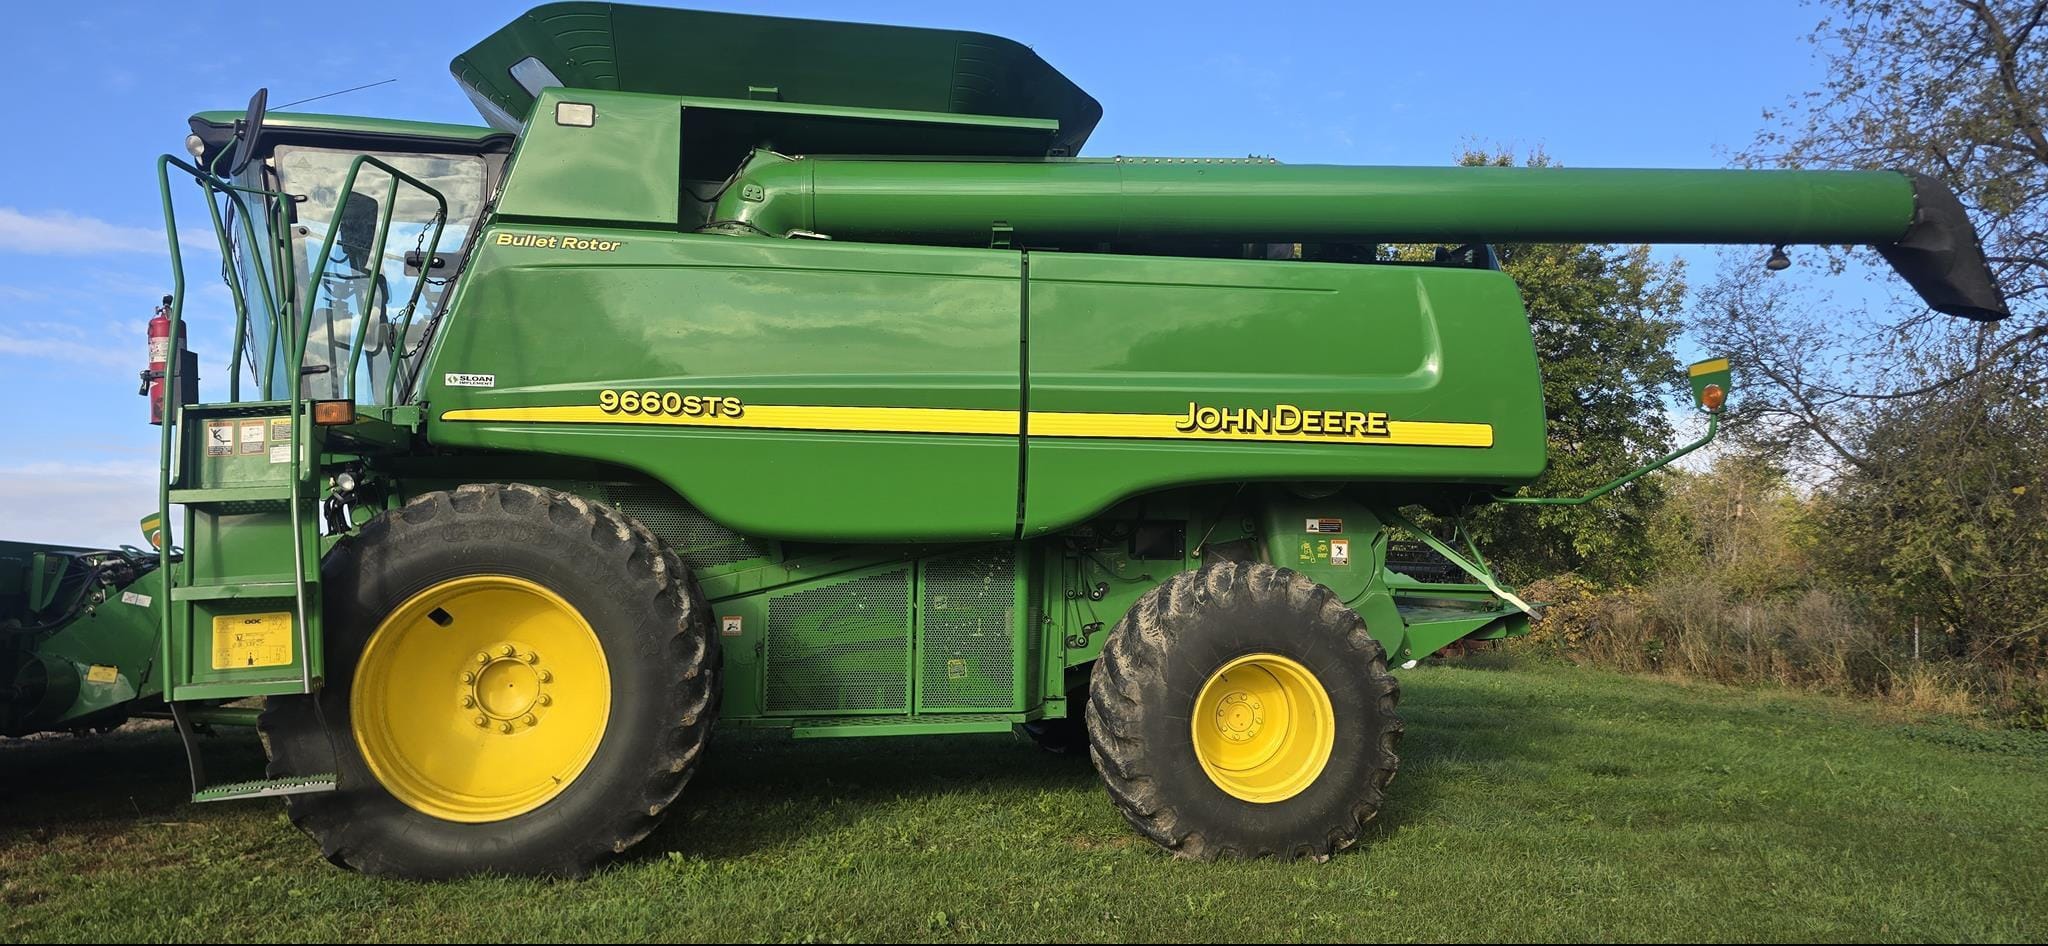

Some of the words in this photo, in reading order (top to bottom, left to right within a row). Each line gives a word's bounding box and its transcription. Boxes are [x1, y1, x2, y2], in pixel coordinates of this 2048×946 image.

[496, 233, 557, 248] Bullet
[561, 236, 622, 252] Rotor
[599, 389, 744, 418] 9660STS
[1176, 402, 1271, 434] JOHN
[1275, 404, 1390, 438] DEERE
